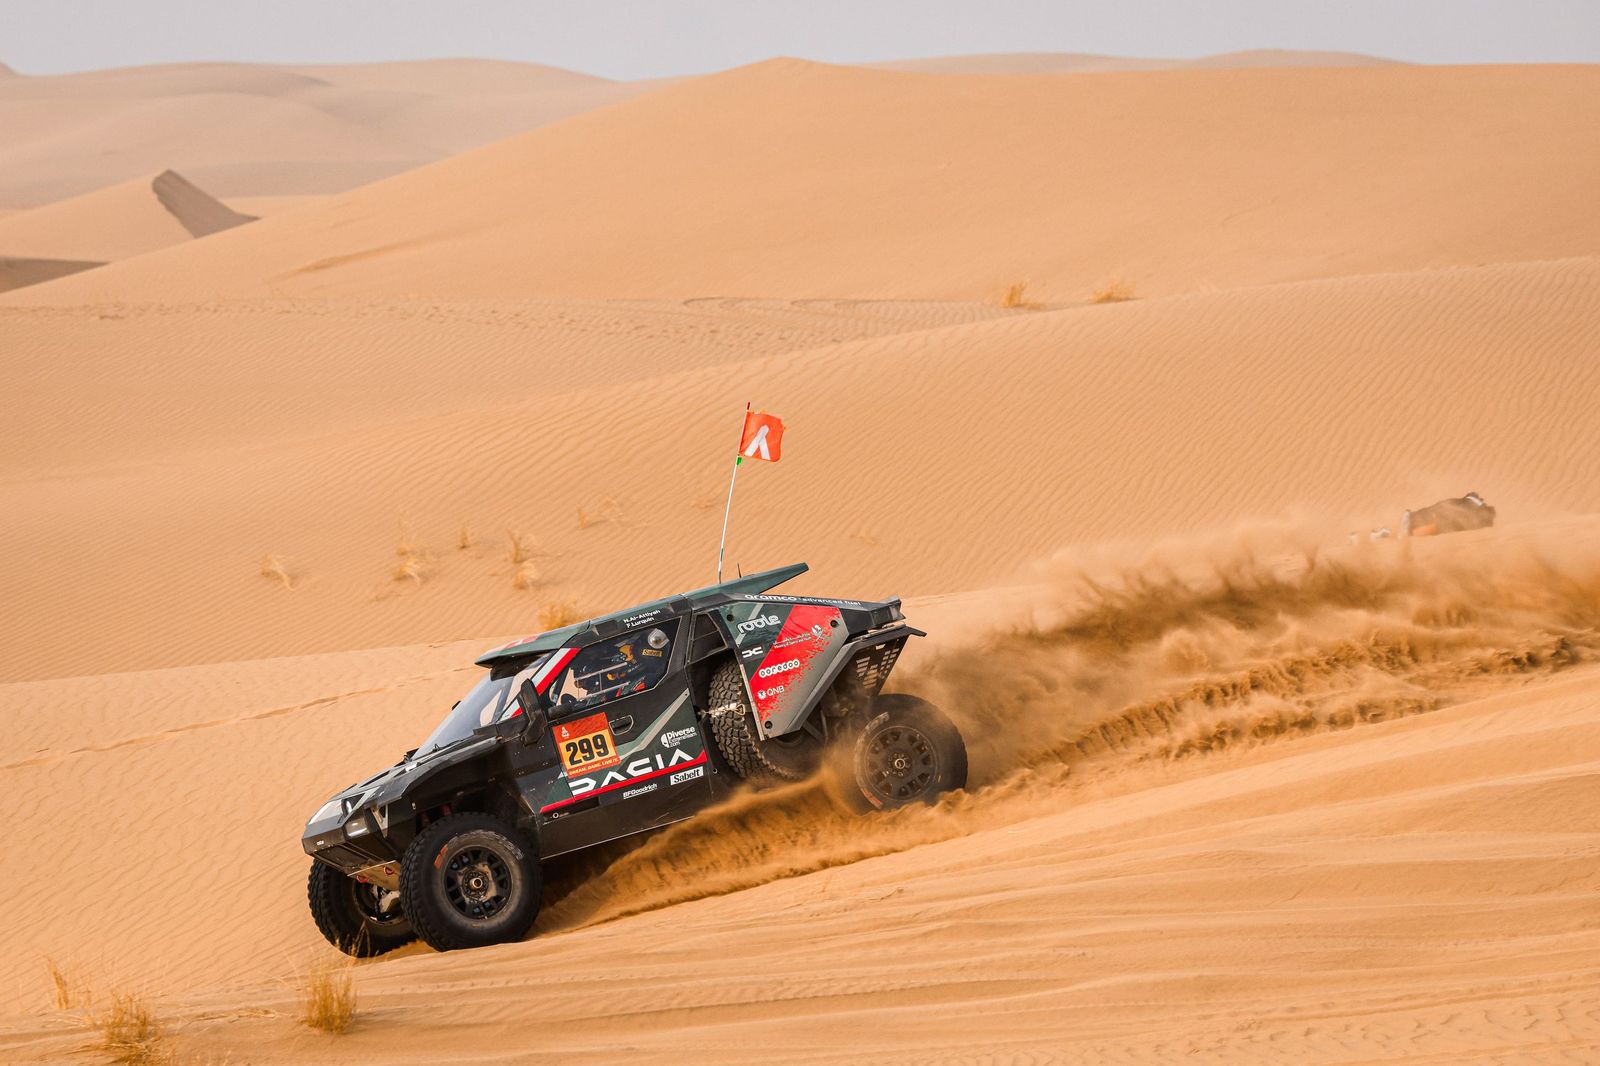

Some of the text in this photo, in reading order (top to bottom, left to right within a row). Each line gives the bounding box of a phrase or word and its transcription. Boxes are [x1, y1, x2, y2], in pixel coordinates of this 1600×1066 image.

[759, 659, 800, 678] ooredoo
[767, 685, 785, 696] QNB
[666, 726, 696, 740] Diverse
[565, 734, 609, 766] 299
[568, 748, 695, 796] DACIA
[673, 769, 700, 783] Sabelt
[622, 783, 658, 798] BFGoodrich
